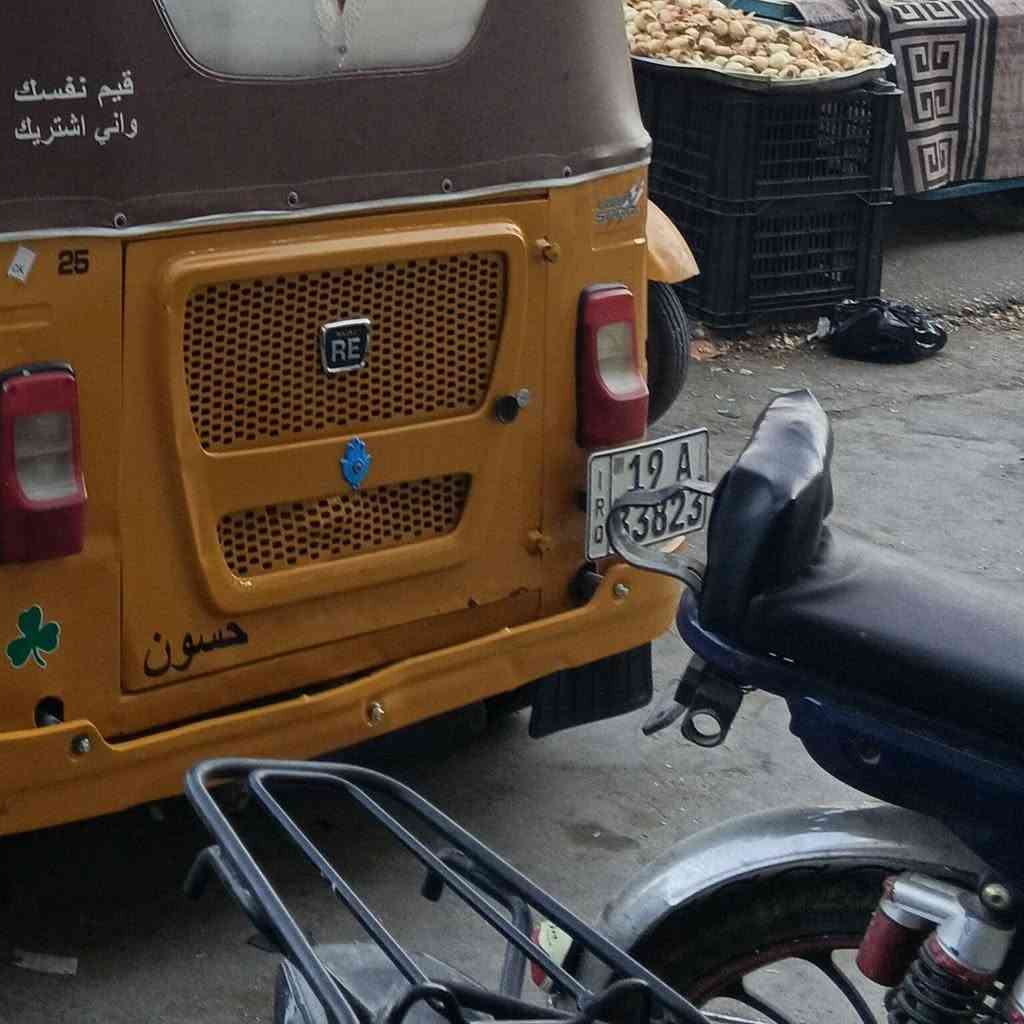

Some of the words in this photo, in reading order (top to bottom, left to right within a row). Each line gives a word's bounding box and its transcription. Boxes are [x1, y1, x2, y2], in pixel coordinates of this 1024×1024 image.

[14, 76, 88, 102] نفسك
[97, 69, 135, 107] قيم
[14, 112, 86, 146] اشتريك
[94, 112, 138, 145] واني
[58, 249, 90, 275] 25
[331, 337, 361, 363] RE
[676, 441, 693, 482] A
[144, 621, 249, 677] حسون
